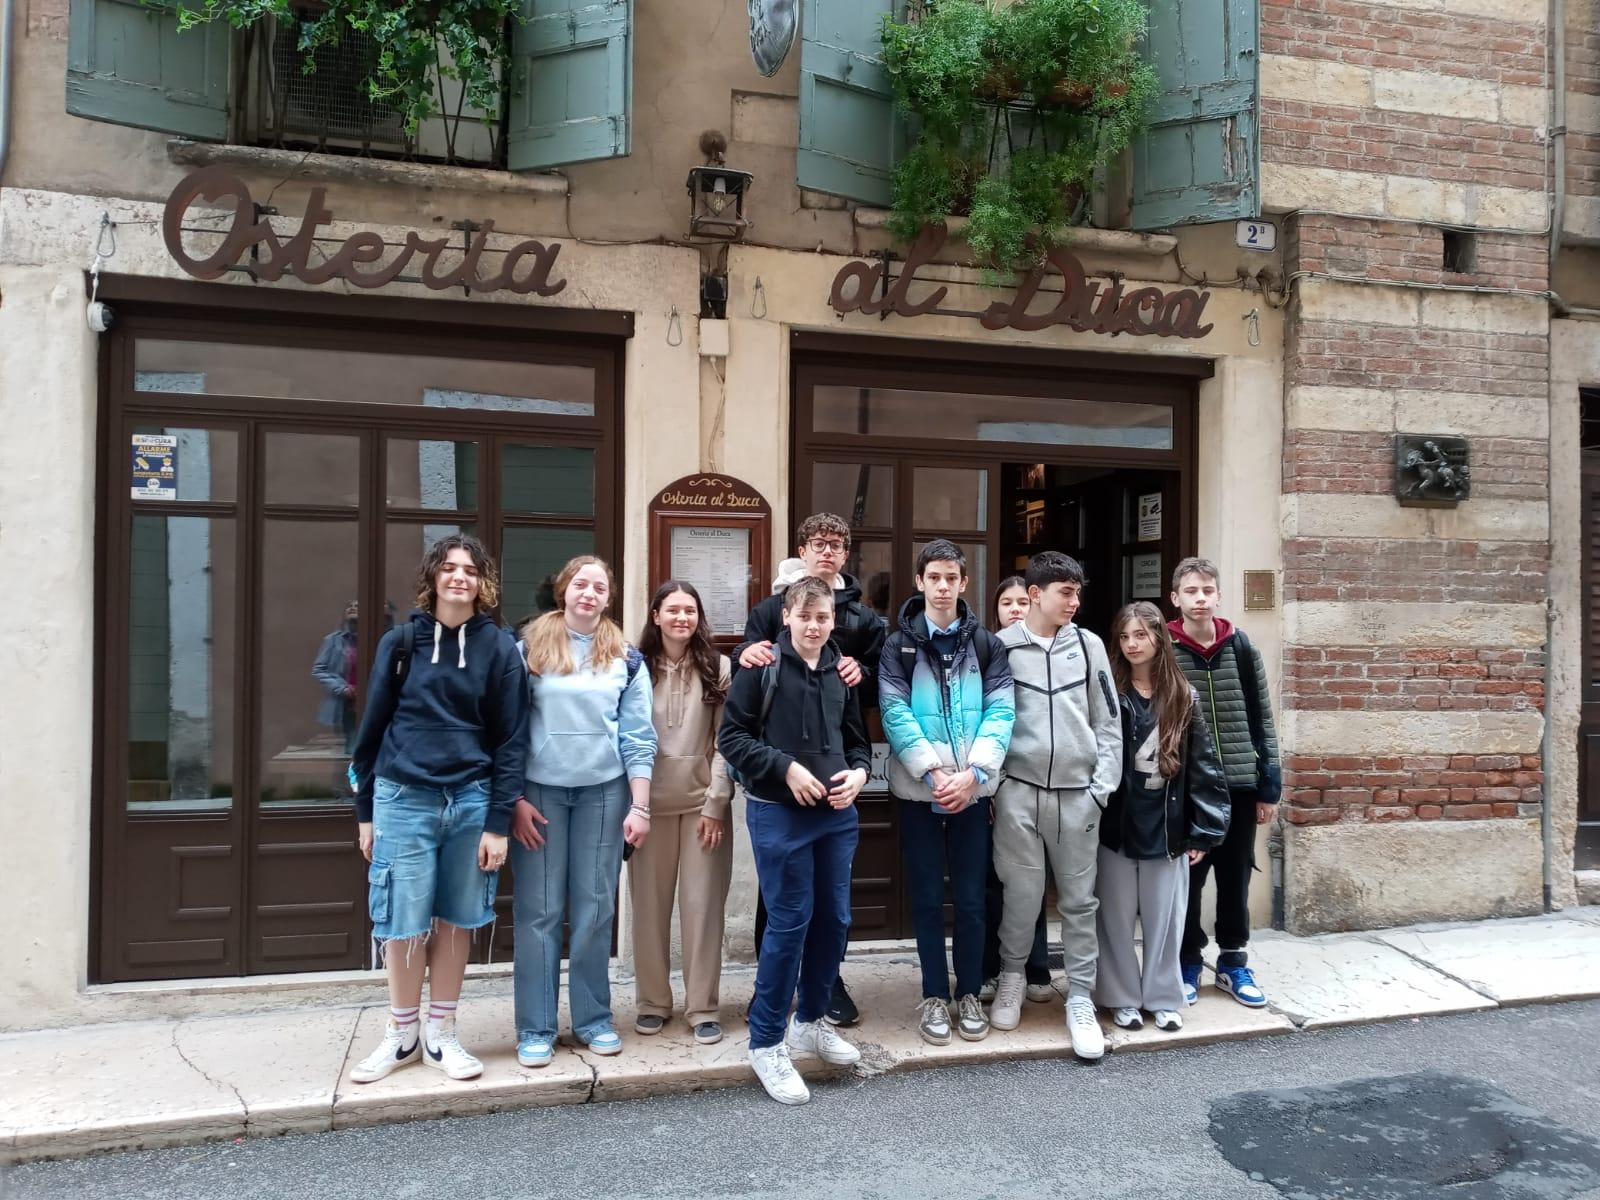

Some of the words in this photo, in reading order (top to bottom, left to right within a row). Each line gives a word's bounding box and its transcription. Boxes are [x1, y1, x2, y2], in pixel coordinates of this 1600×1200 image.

[163, 165, 567, 297] Osteria
[830, 221, 947, 317] al
[980, 238, 1214, 338] Duca
[662, 491, 707, 505] Osteria
[711, 492, 724, 506] al
[727, 492, 760, 507] Duca
[690, 529, 709, 537] Osteria
[1135, 721, 1166, 790] 4
